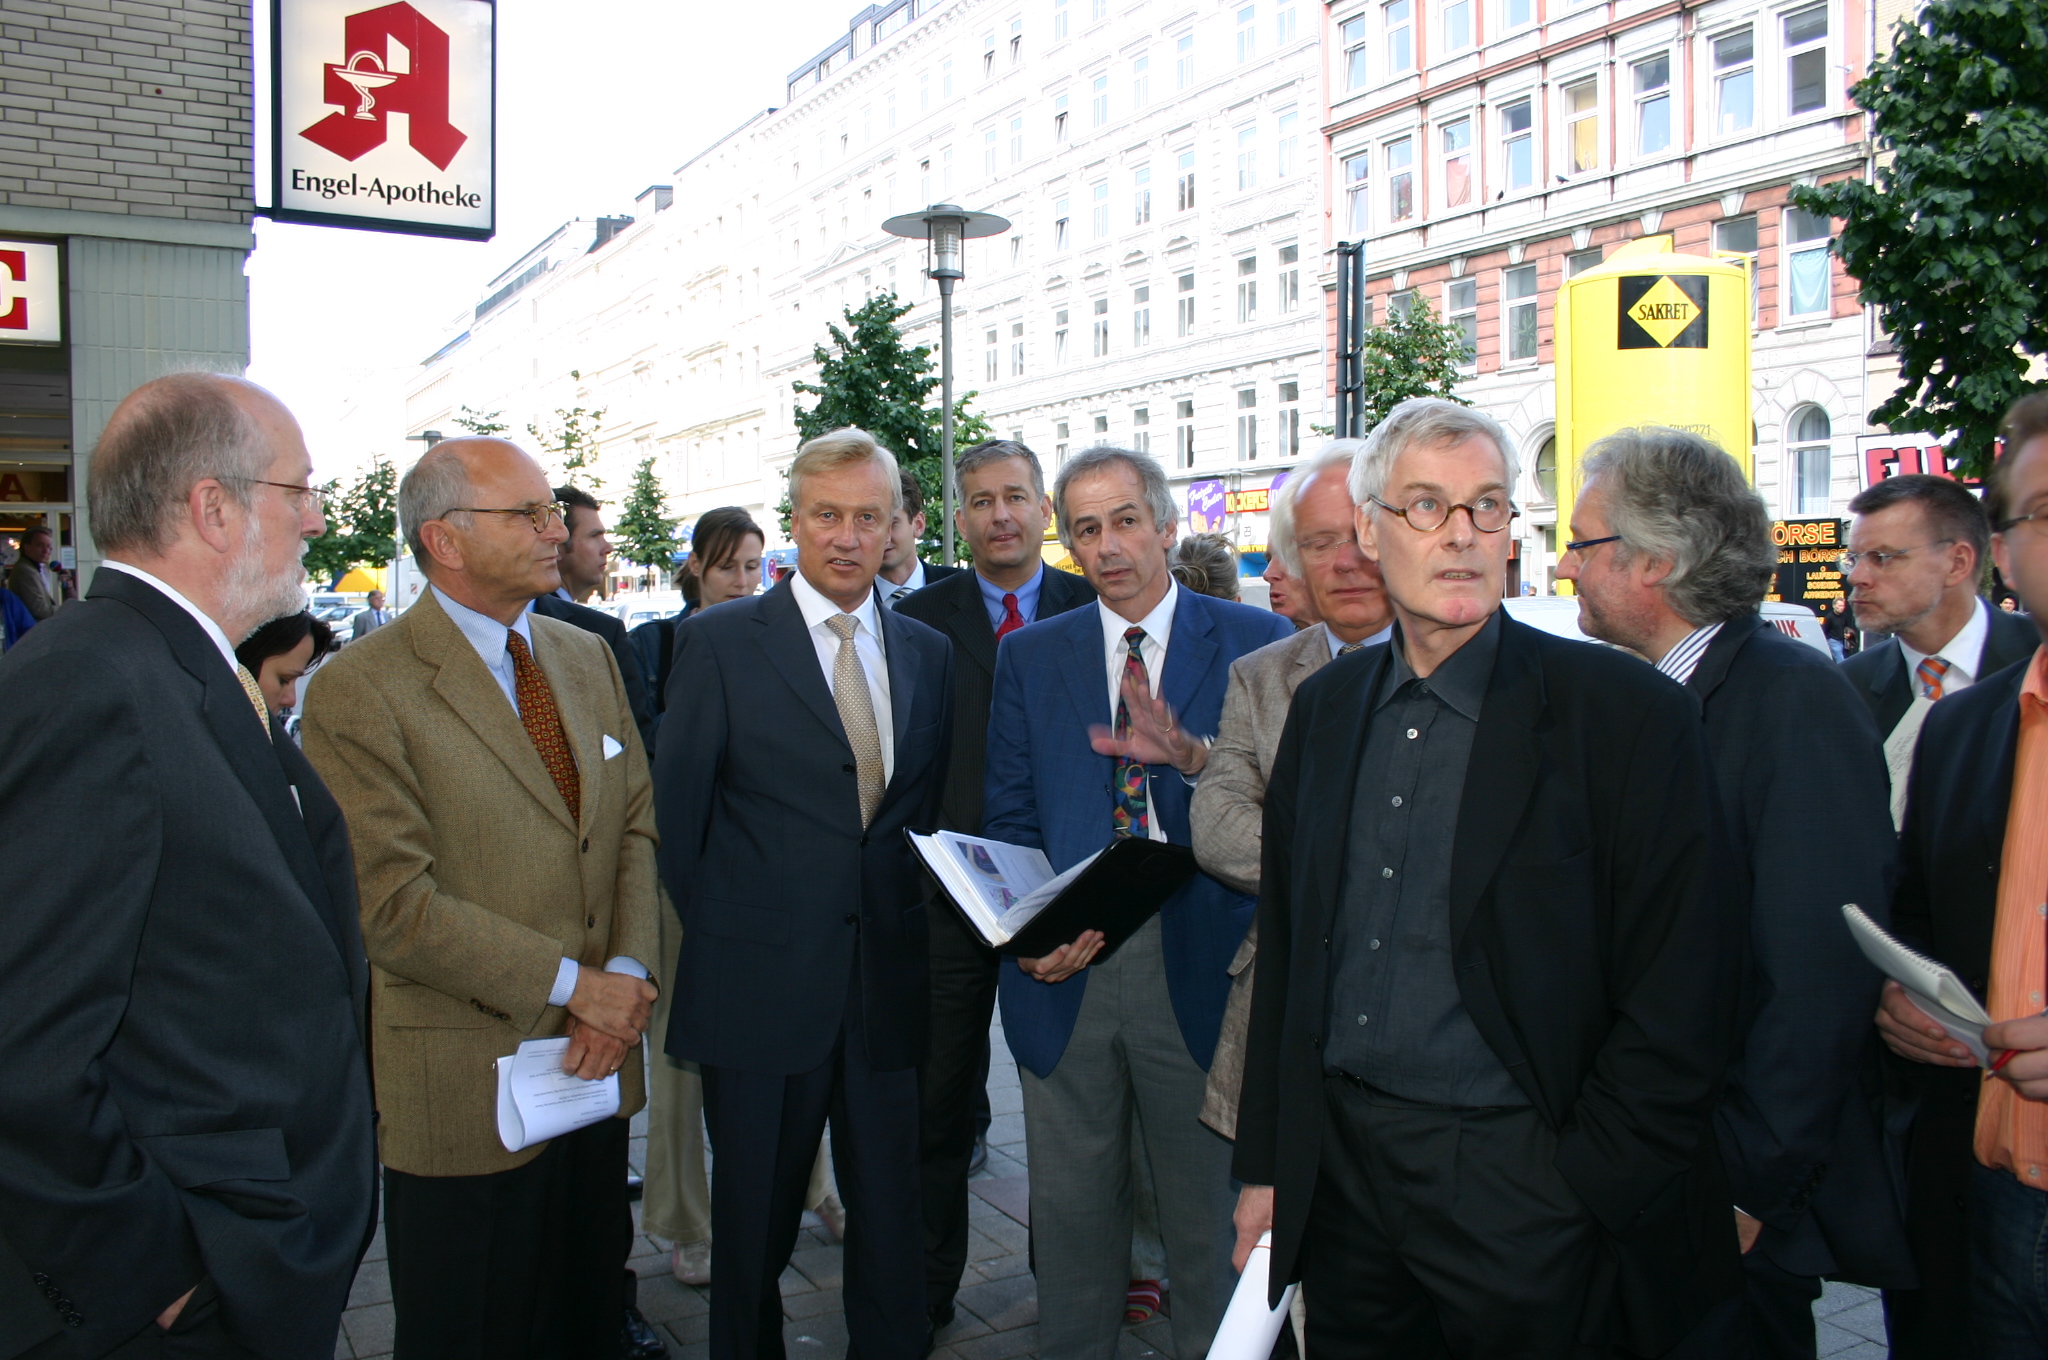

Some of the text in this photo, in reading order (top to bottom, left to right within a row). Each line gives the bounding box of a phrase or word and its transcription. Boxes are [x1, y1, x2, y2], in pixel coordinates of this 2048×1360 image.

[291, 168, 482, 208] Engel-Apotheke
[1637, 303, 1689, 320] SAKRET
[1225, 489, 1268, 513] KICKERS
